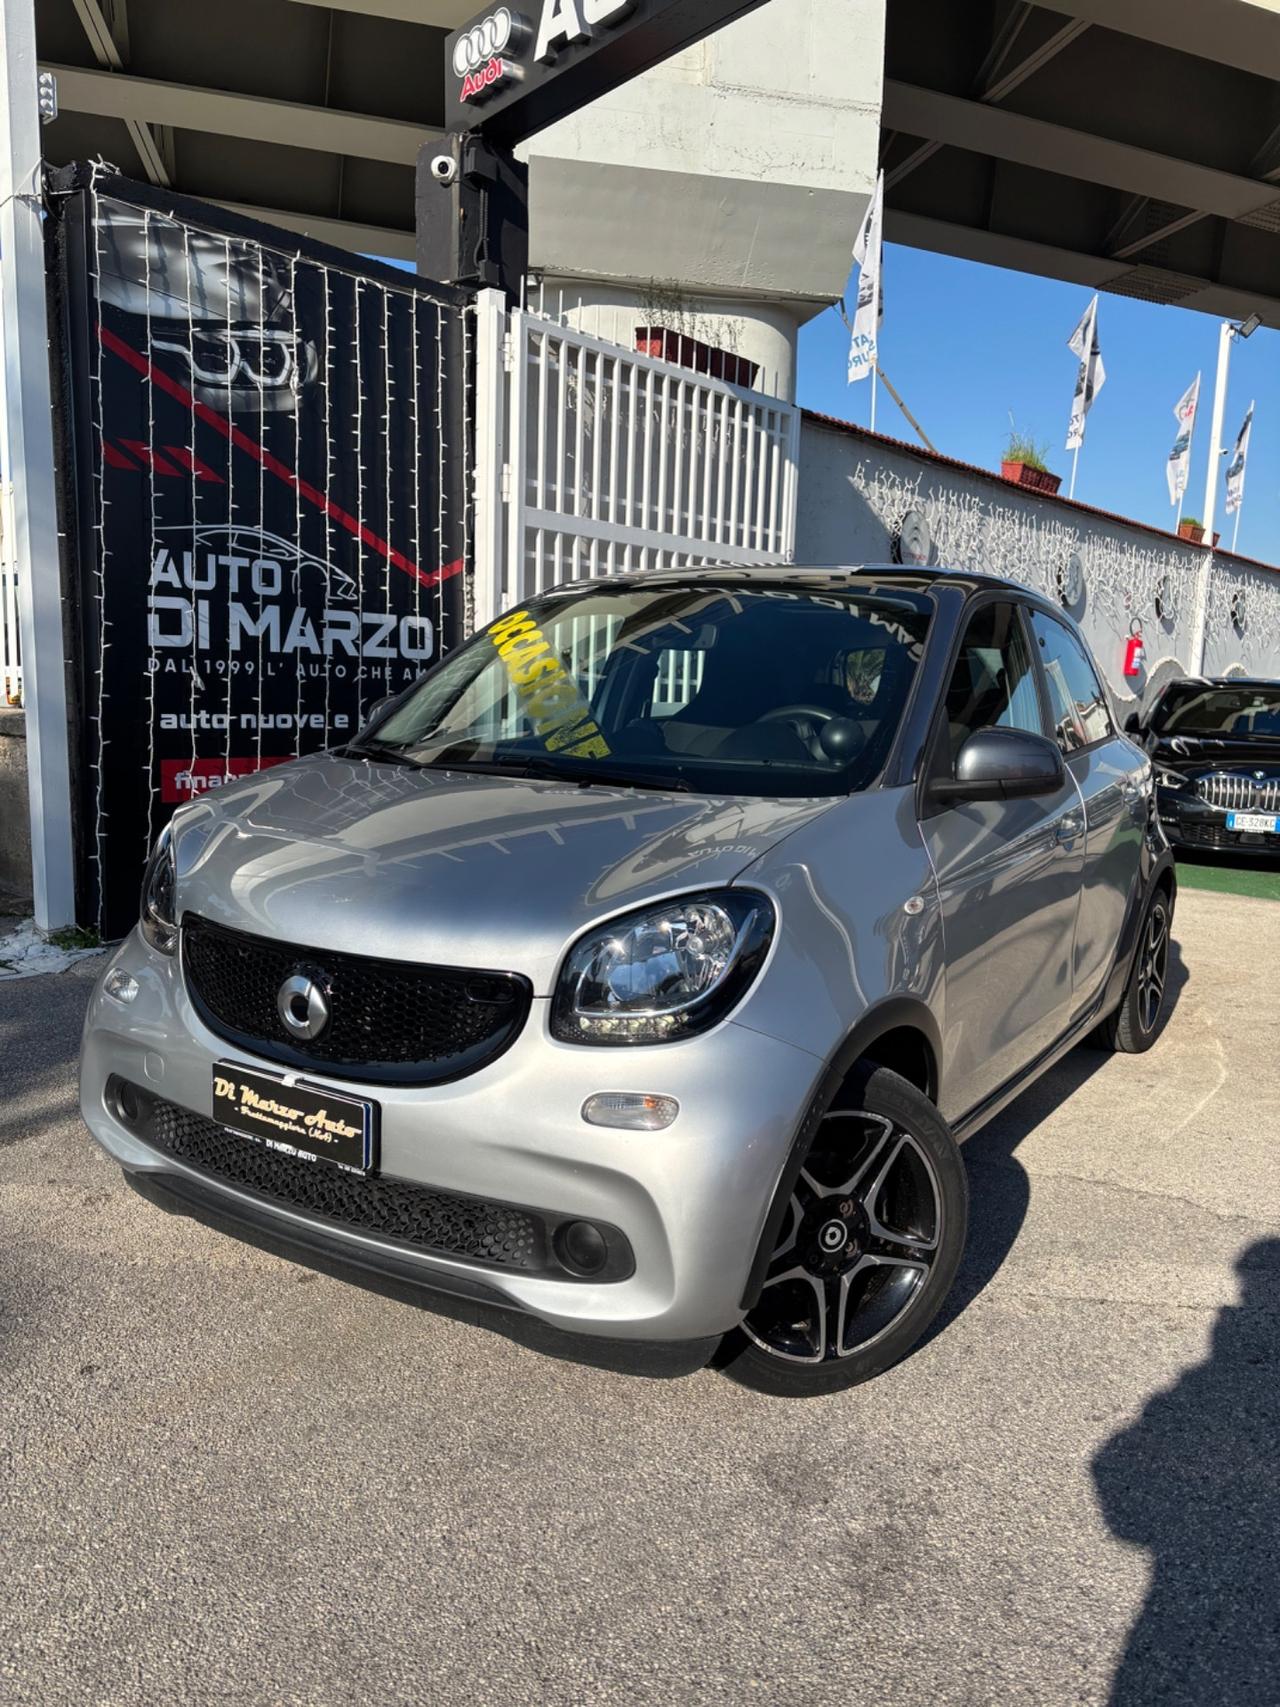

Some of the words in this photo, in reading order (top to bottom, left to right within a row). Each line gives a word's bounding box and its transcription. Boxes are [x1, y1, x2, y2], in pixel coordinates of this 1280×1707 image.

[459, 57, 504, 103] Audi
[147, 548, 282, 597] AUTO
[147, 595, 210, 649] DI
[228, 601, 434, 660] MARZO
[147, 657, 191, 674] DAL
[203, 658, 255, 675] 1999
[266, 661, 284, 677] L'
[295, 664, 347, 679] AUTO
[357, 665, 393, 680] CHE
[159, 709, 229, 729] auto
[240, 713, 325, 729] nuove
[334, 713, 349, 729] e
[213, 1077, 237, 1100] Di
[239, 1084, 305, 1121] Marzo
[303, 1109, 363, 1138] Auto
[273, 1141, 298, 1156] MARZO
[297, 1150, 318, 1162] AUTO
